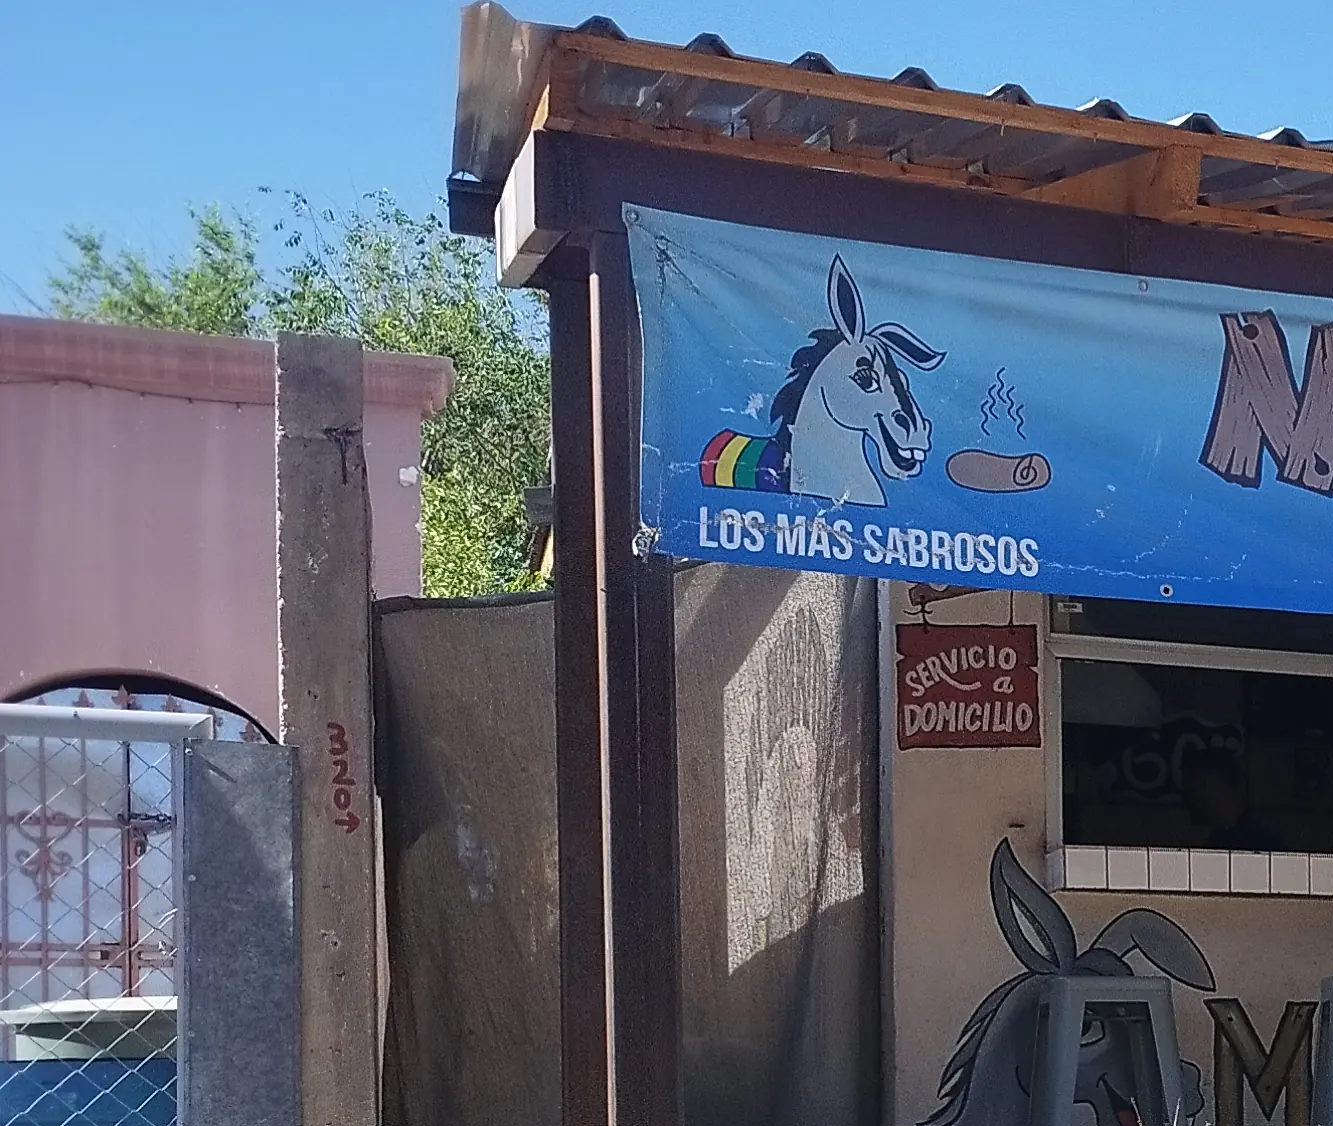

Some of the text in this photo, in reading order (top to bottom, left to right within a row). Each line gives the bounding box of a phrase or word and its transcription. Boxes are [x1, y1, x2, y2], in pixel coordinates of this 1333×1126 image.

[700, 506, 765, 551] LOS
[863, 524, 1040, 577] SABROSOS
[905, 645, 1017, 697] SERVICIO
[904, 701, 1034, 736] DOMICILIO
[327, 722, 356, 810] 320
